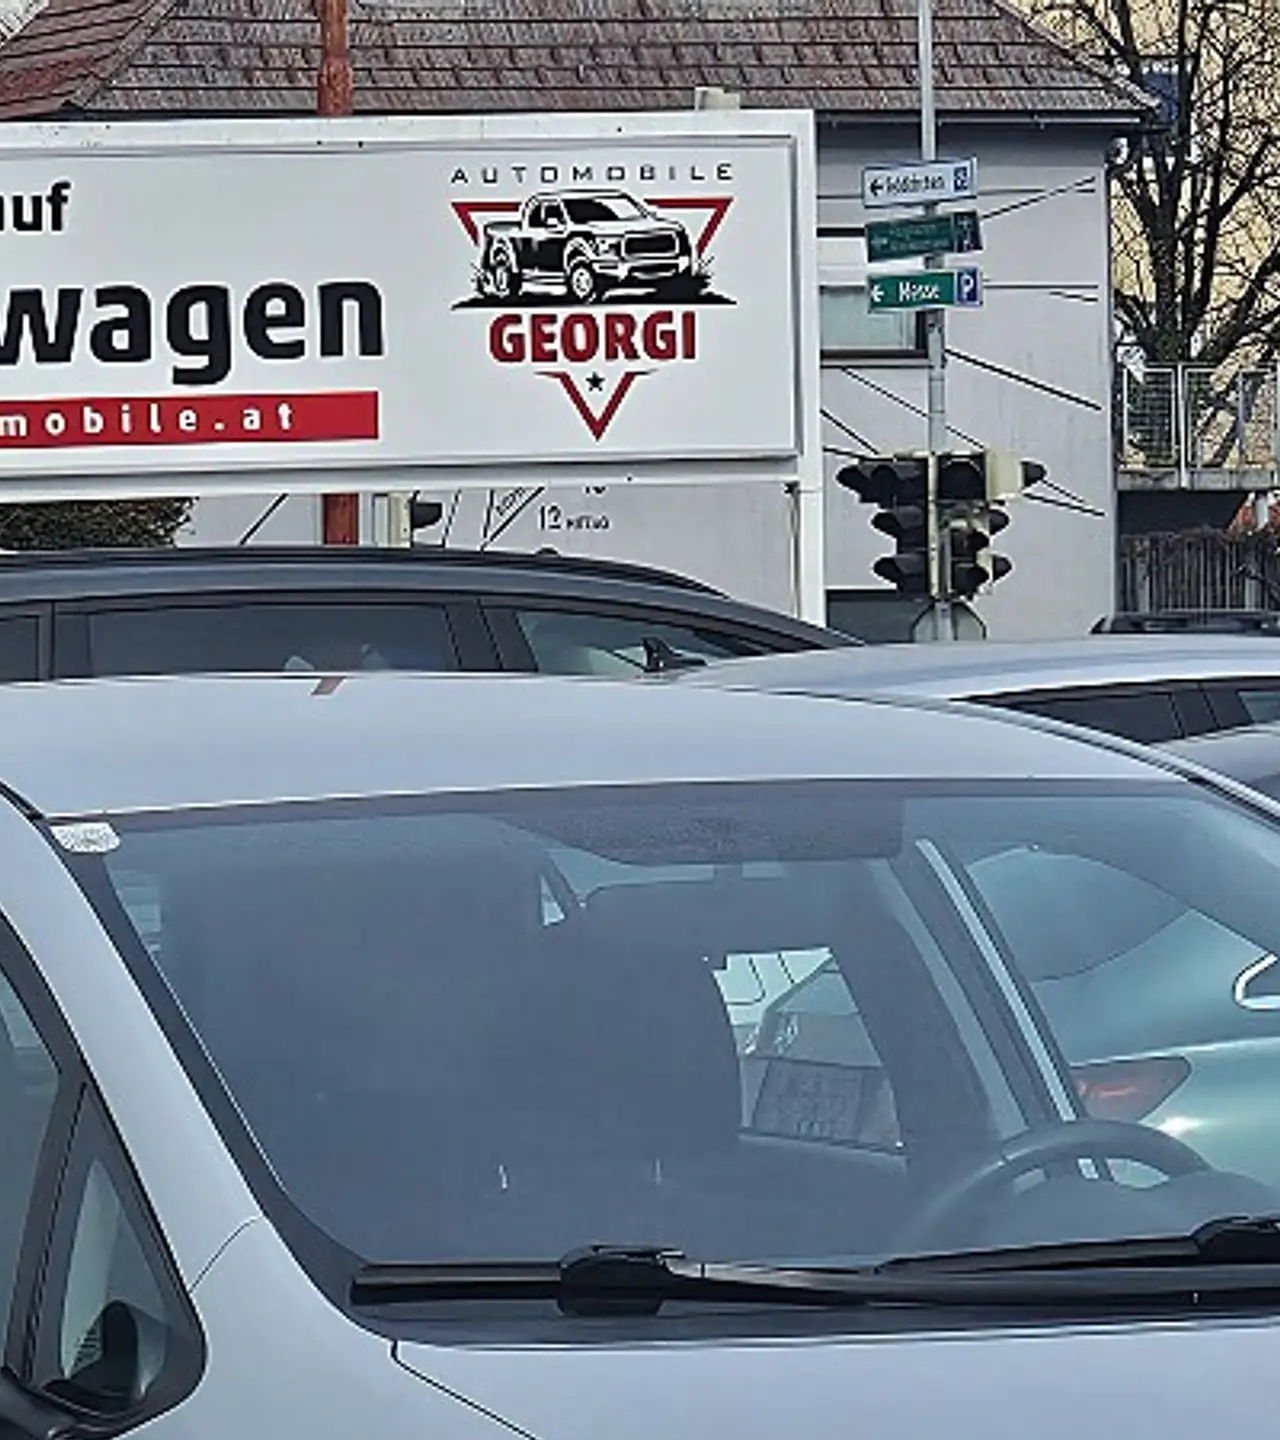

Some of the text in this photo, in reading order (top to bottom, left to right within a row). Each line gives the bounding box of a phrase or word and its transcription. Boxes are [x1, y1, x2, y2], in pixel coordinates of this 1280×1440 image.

[451, 163, 733, 183] AUTOMOBILE
[489, 311, 697, 362] GEORGI
[541, 505, 562, 530] 12
